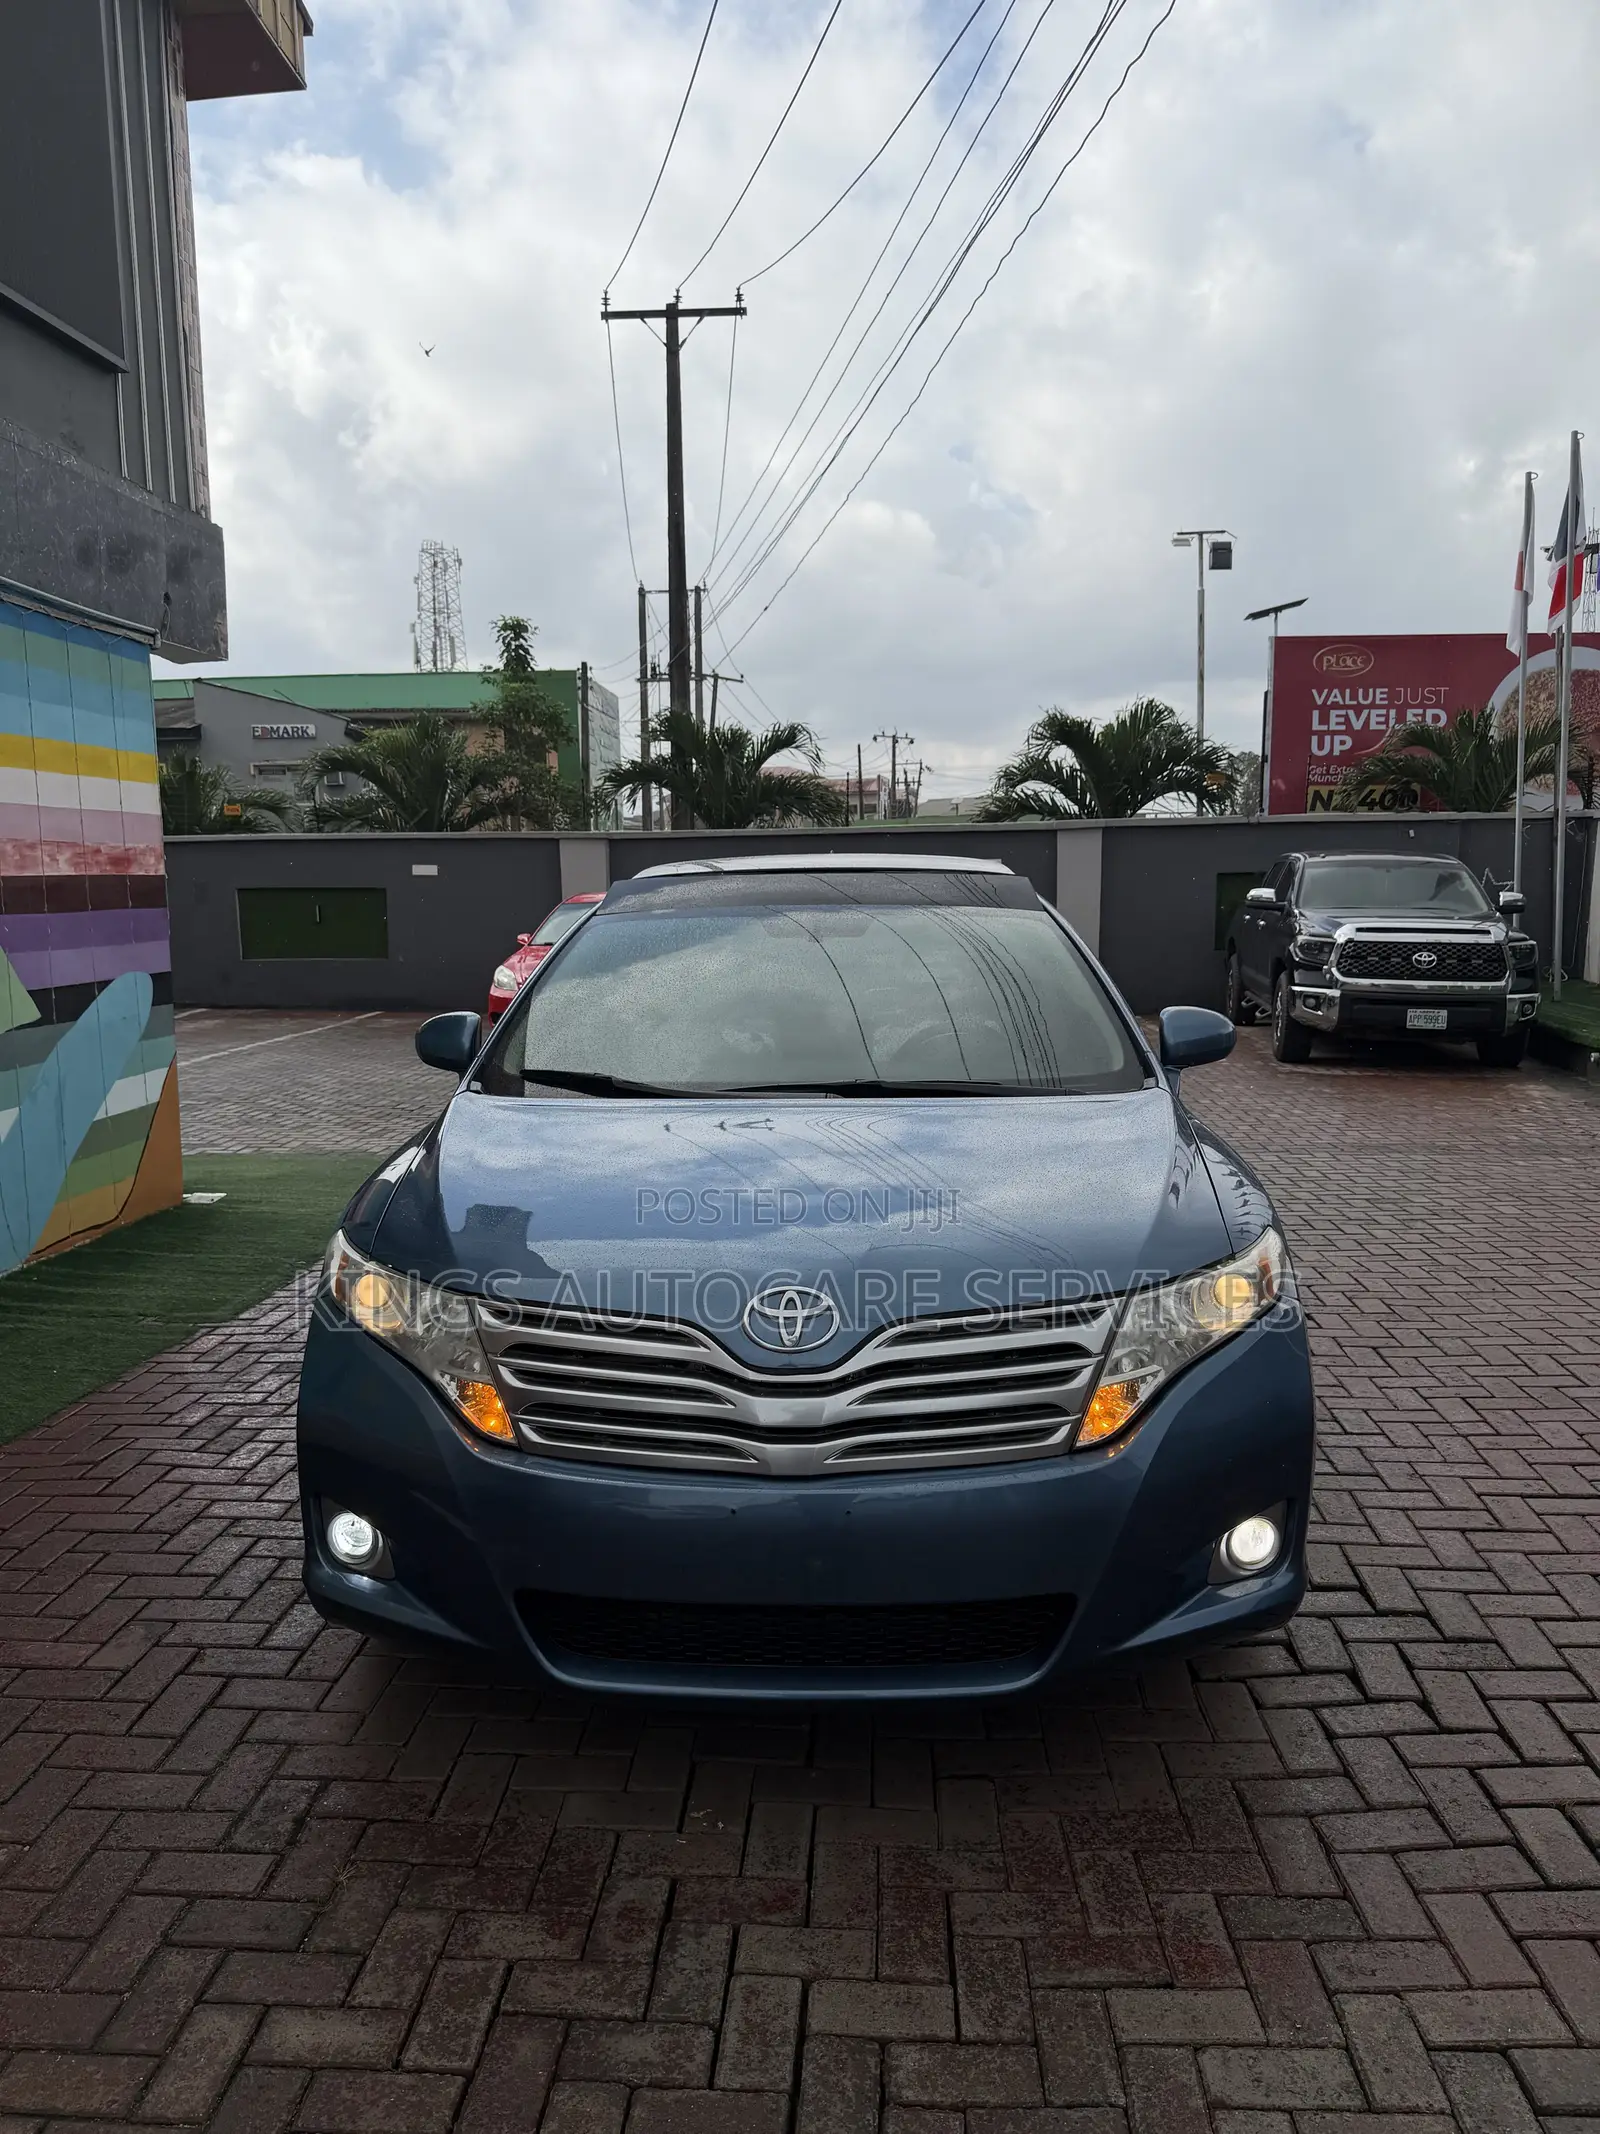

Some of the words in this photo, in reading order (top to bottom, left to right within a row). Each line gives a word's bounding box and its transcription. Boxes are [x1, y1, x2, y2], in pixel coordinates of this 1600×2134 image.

[1311, 687, 1389, 705] VALUE
[1394, 687, 1450, 704] JUST
[252, 726, 311, 738] EDMARK
[1310, 735, 1353, 756] UP
